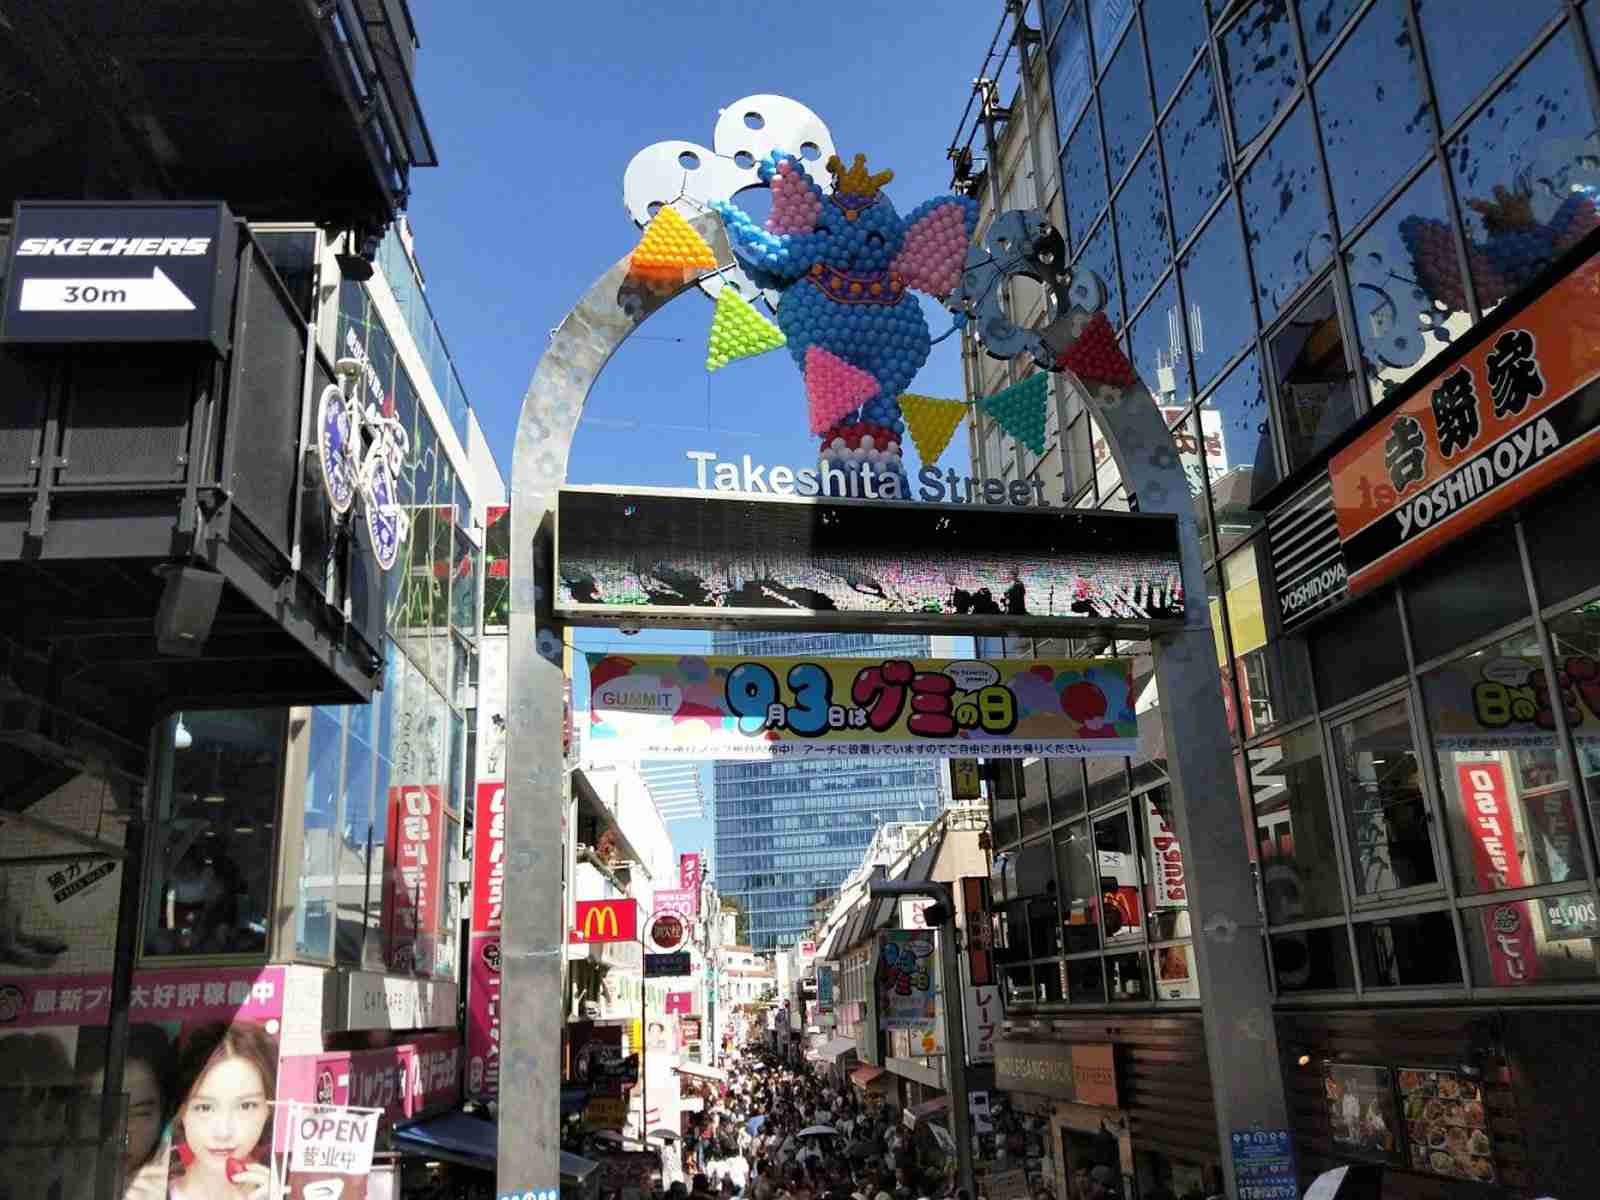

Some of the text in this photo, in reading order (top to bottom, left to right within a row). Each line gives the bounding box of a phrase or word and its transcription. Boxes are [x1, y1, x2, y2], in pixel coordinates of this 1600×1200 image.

[16, 237, 211, 257] SKECHERS
[63, 286, 127, 305] 30m
[1384, 328, 1546, 493] 吉野家
[686, 450, 1050, 507] Takeshita Street
[1395, 417, 1560, 540] YOSHINOYA
[1281, 562, 1348, 614] YOSHINOYA
[602, 691, 673, 707] GUMMIT
[301, 1118, 368, 1143] OPEN
